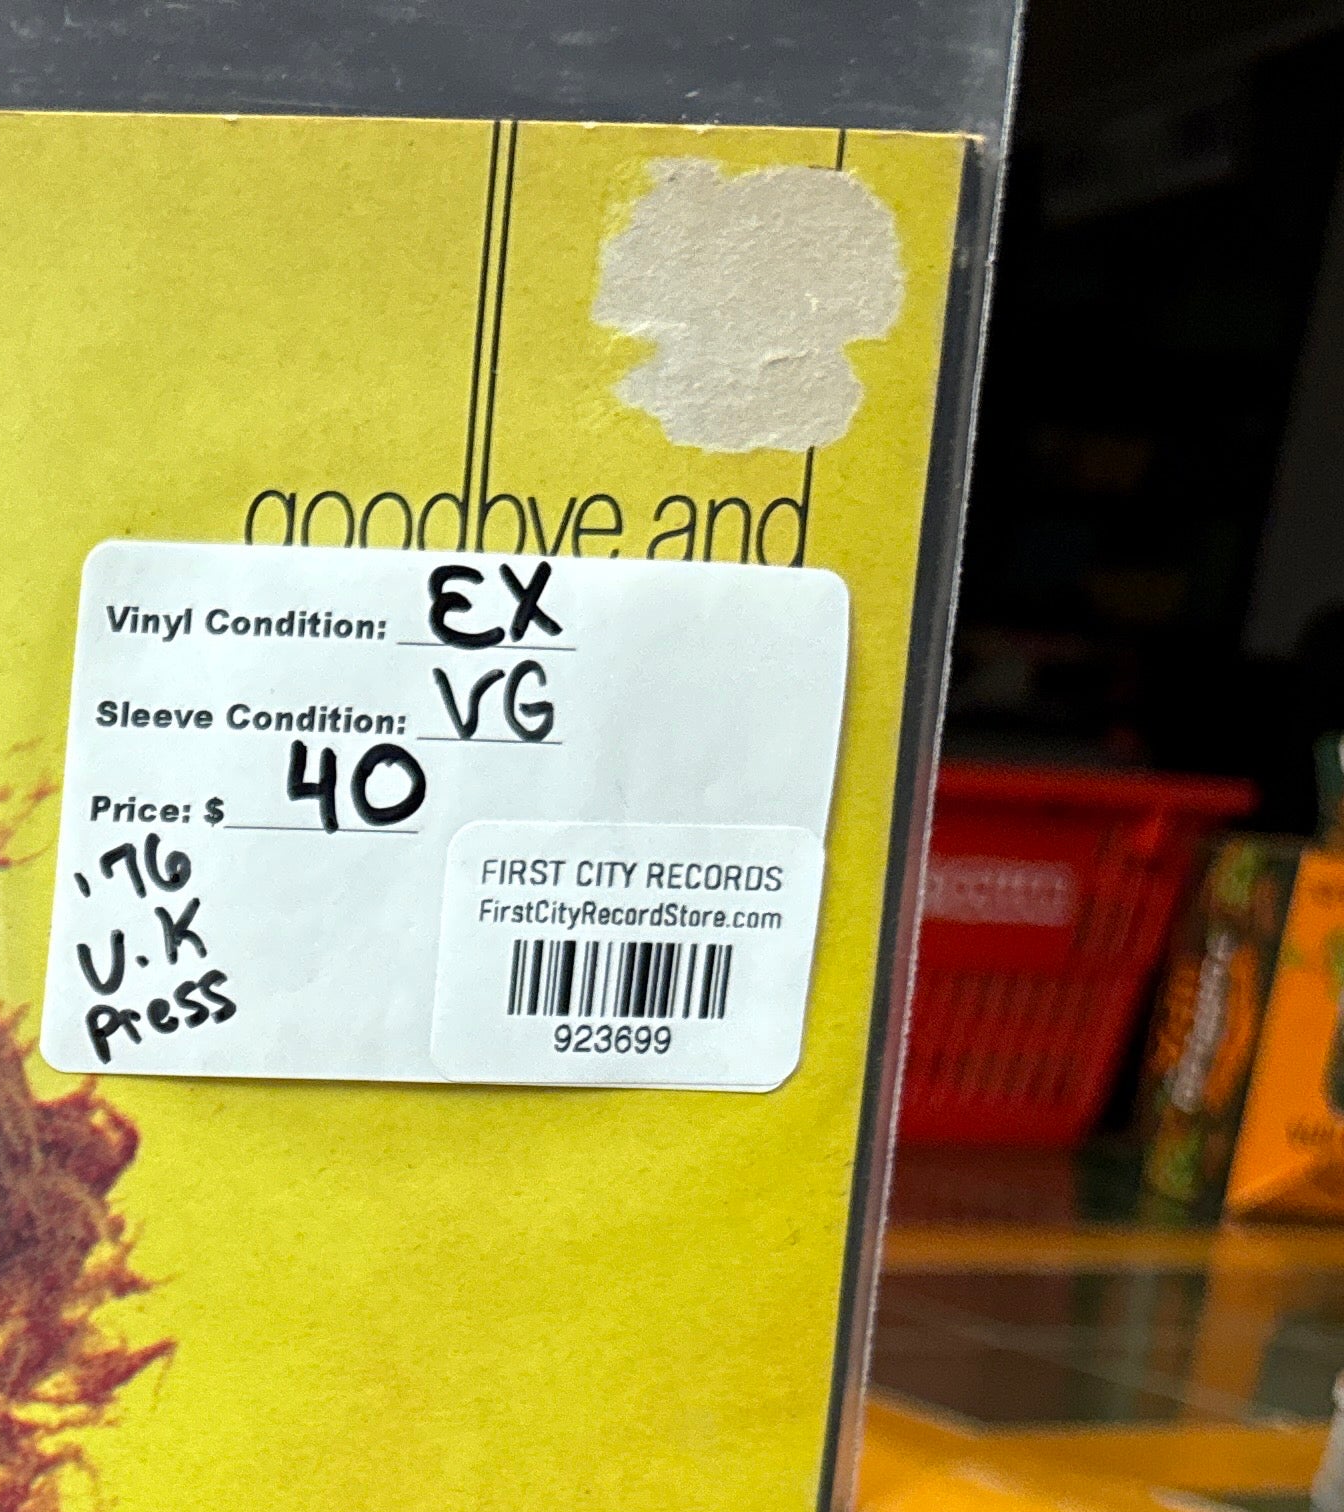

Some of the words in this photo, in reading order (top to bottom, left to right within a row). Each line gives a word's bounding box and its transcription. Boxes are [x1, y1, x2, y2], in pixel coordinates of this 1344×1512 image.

[645, 468, 814, 568] and
[105, 604, 194, 643] Vinyl
[204, 609, 387, 641] Condition:
[428, 561, 564, 650] EX
[95, 700, 214, 730] Sleeve
[225, 703, 407, 736] Condition:
[432, 659, 556, 743] VG
[89, 795, 192, 825] Price:
[203, 796, 225, 828] $
[286, 739, 427, 834] 40
[477, 898, 784, 931] FirstCityRecordStore.com
[480, 859, 567, 887] FIRST
[575, 861, 638, 889] CITY
[645, 863, 785, 892] RECORDS
[552, 1024, 674, 1055] 923699
